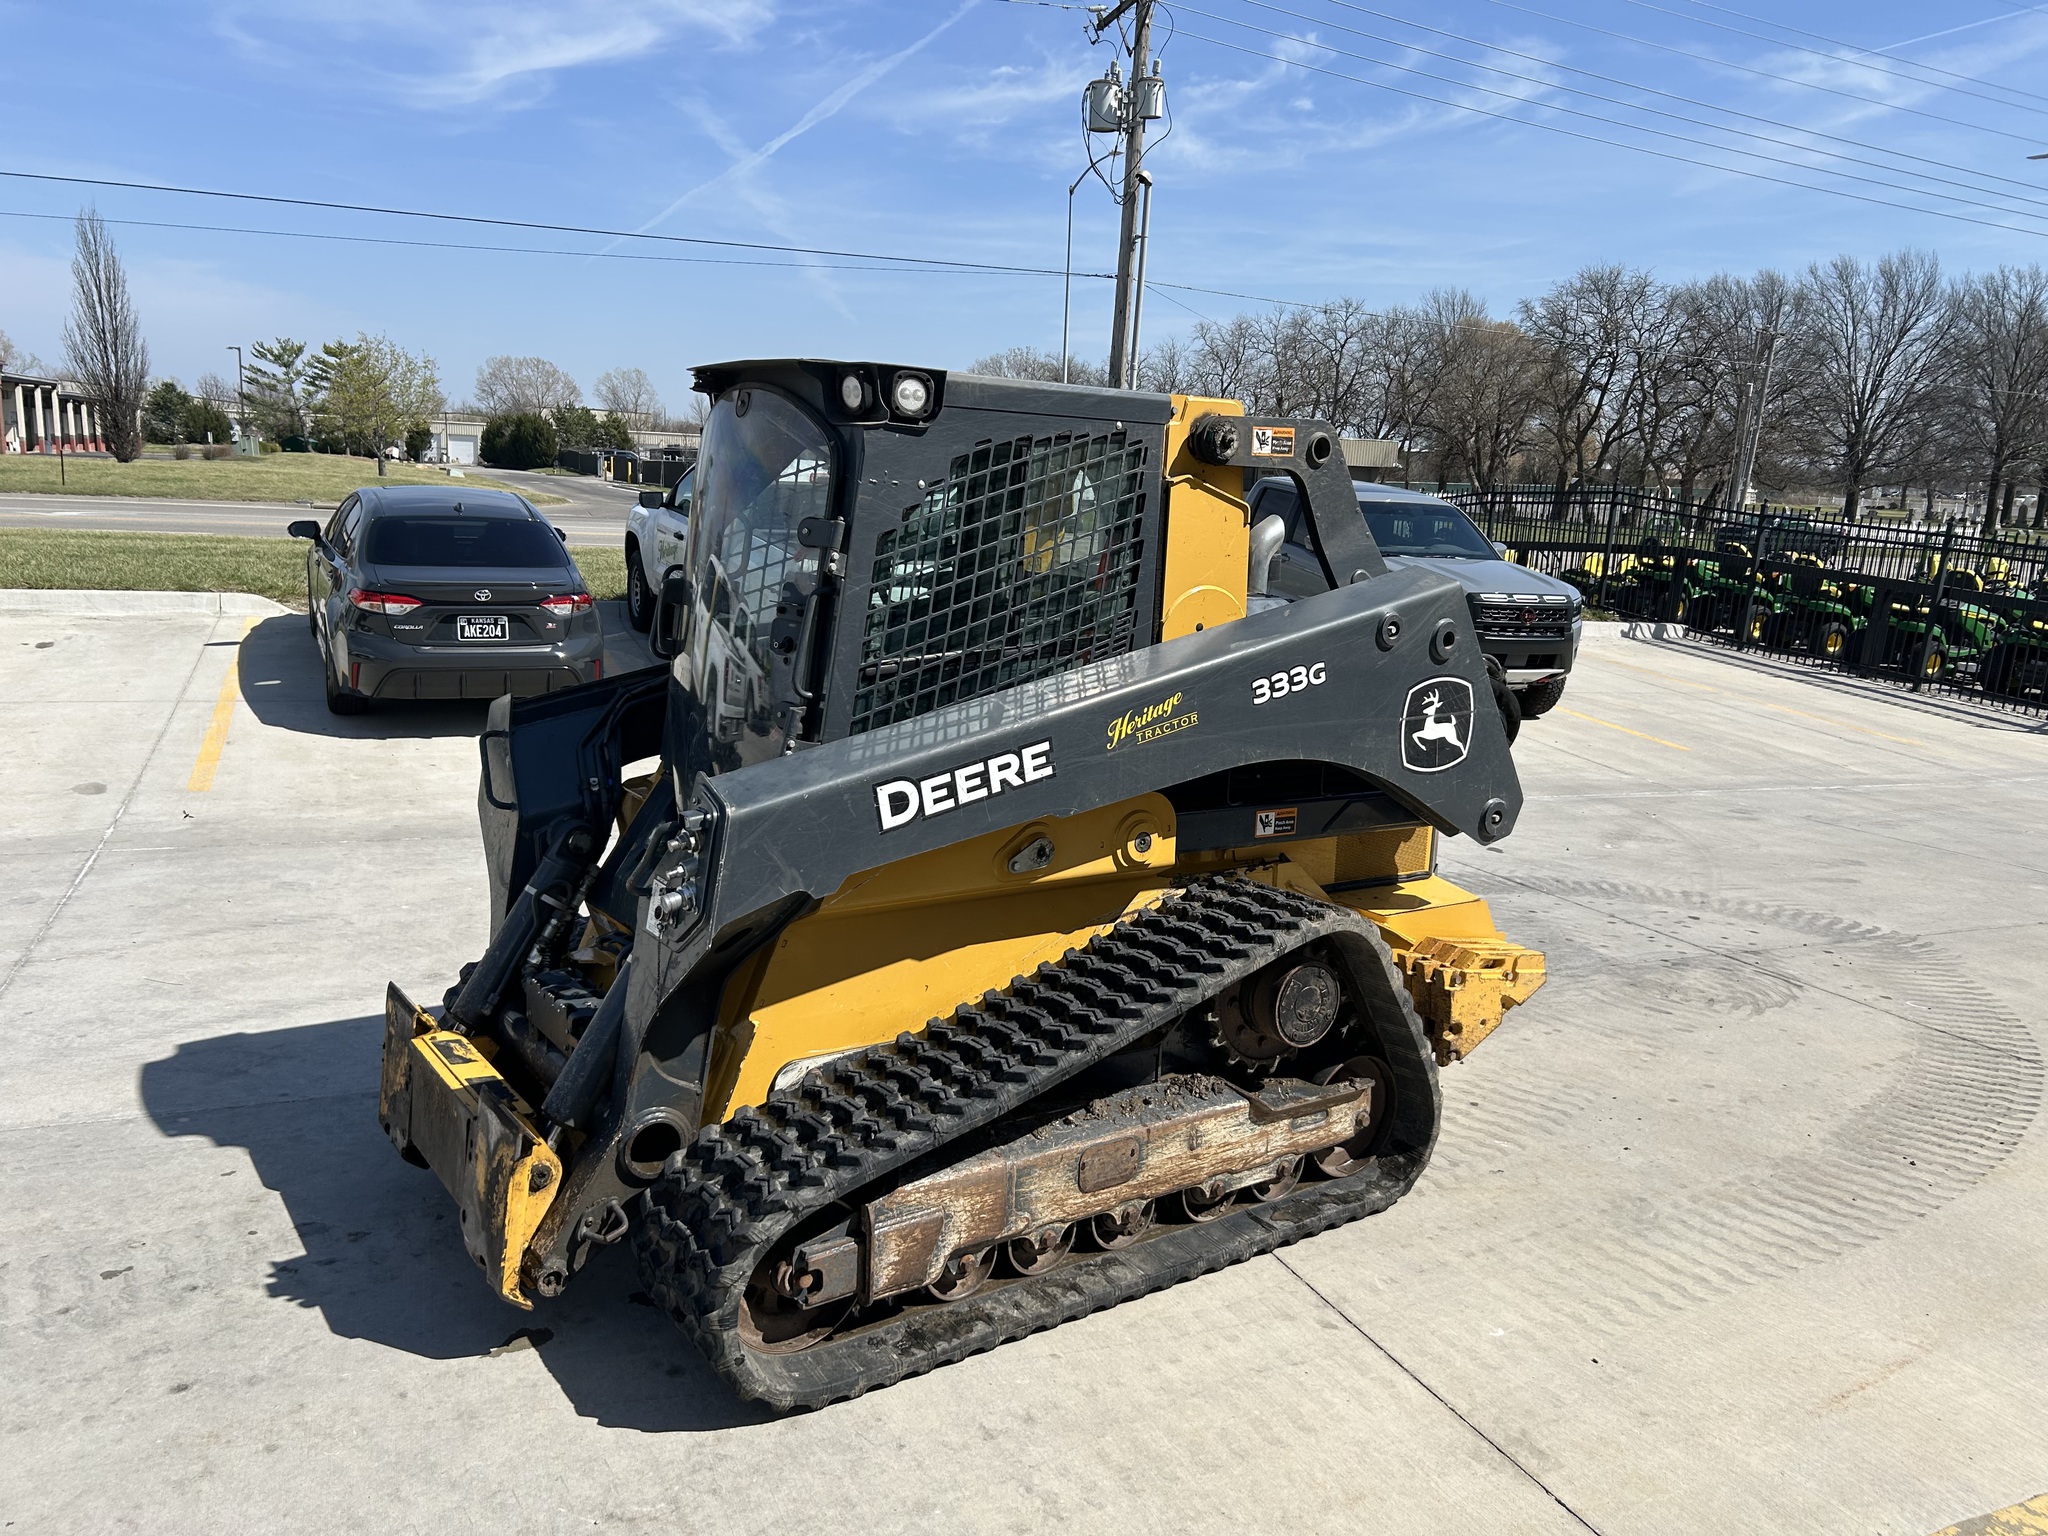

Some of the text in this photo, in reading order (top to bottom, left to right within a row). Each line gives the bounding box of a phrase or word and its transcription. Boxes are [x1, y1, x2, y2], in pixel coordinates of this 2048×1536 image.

[464, 625, 502, 637] AKE204
[1252, 662, 1326, 705] 333G
[1107, 691, 1183, 750] Heritage
[1136, 714, 1198, 742] TRACTOR
[876, 741, 1053, 830] DEERE
